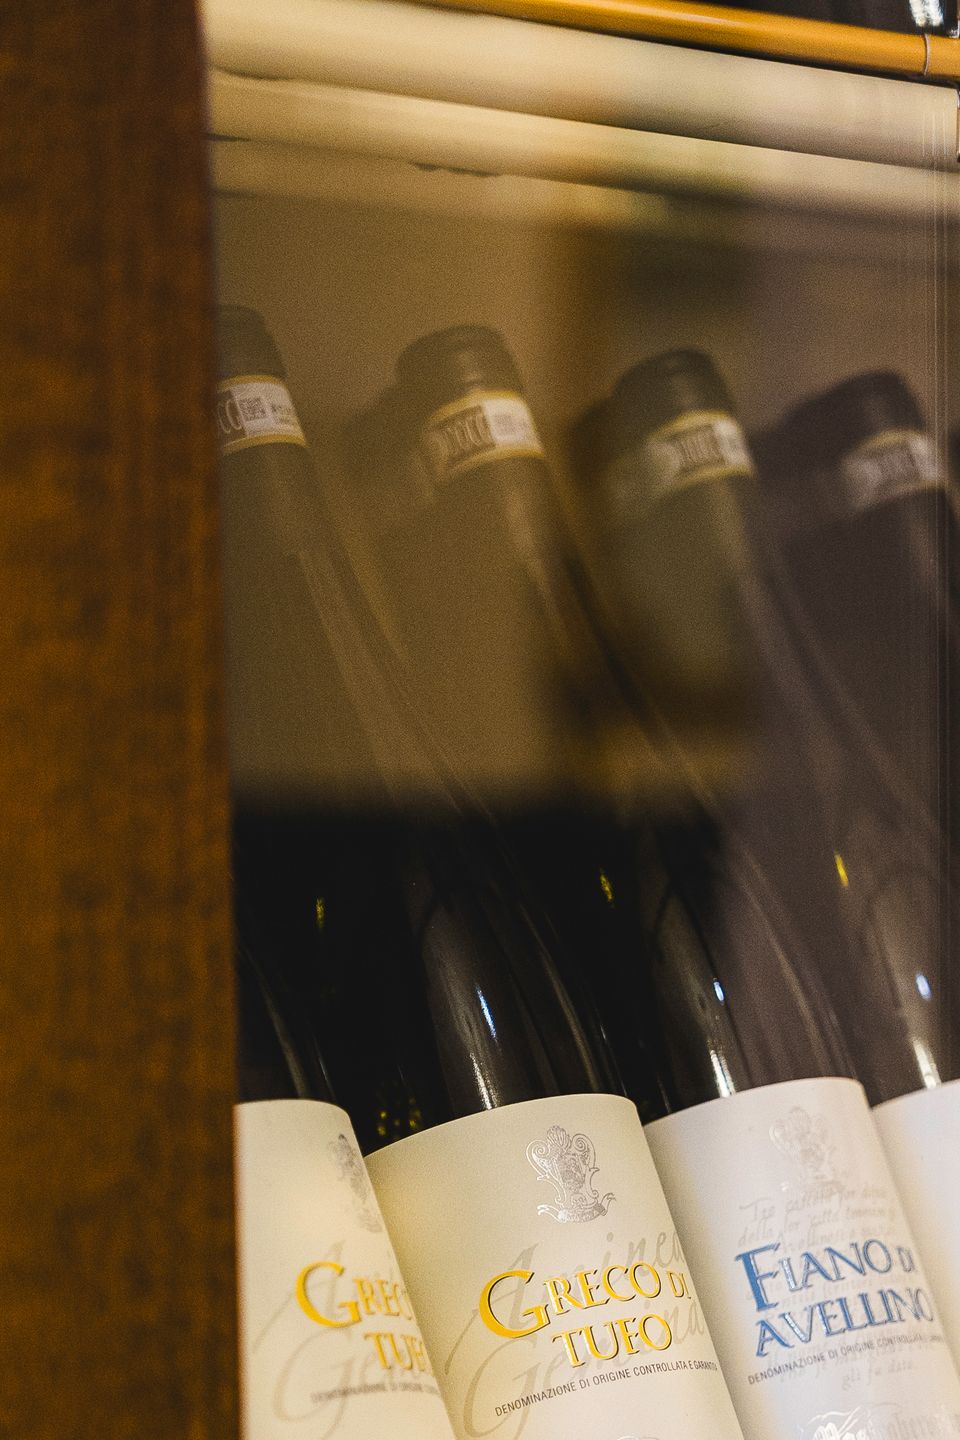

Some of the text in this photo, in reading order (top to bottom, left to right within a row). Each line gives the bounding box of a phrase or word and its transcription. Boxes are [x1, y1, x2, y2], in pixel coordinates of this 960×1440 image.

[479, 1261, 692, 1339] GRECO DI
[734, 1238, 893, 1312] FIANO
[552, 1313, 673, 1370] TUFO
[755, 1287, 935, 1358] AVELLINO
[494, 1381, 577, 1417] DENOMINAZIONE
[579, 1376, 591, 1390] DI
[592, 1368, 632, 1387] ORIGINE
[633, 1360, 687, 1377] CONTROLLATA
[747, 1353, 826, 1385] DENOMINAZIONE
[828, 1349, 840, 1361] DI
